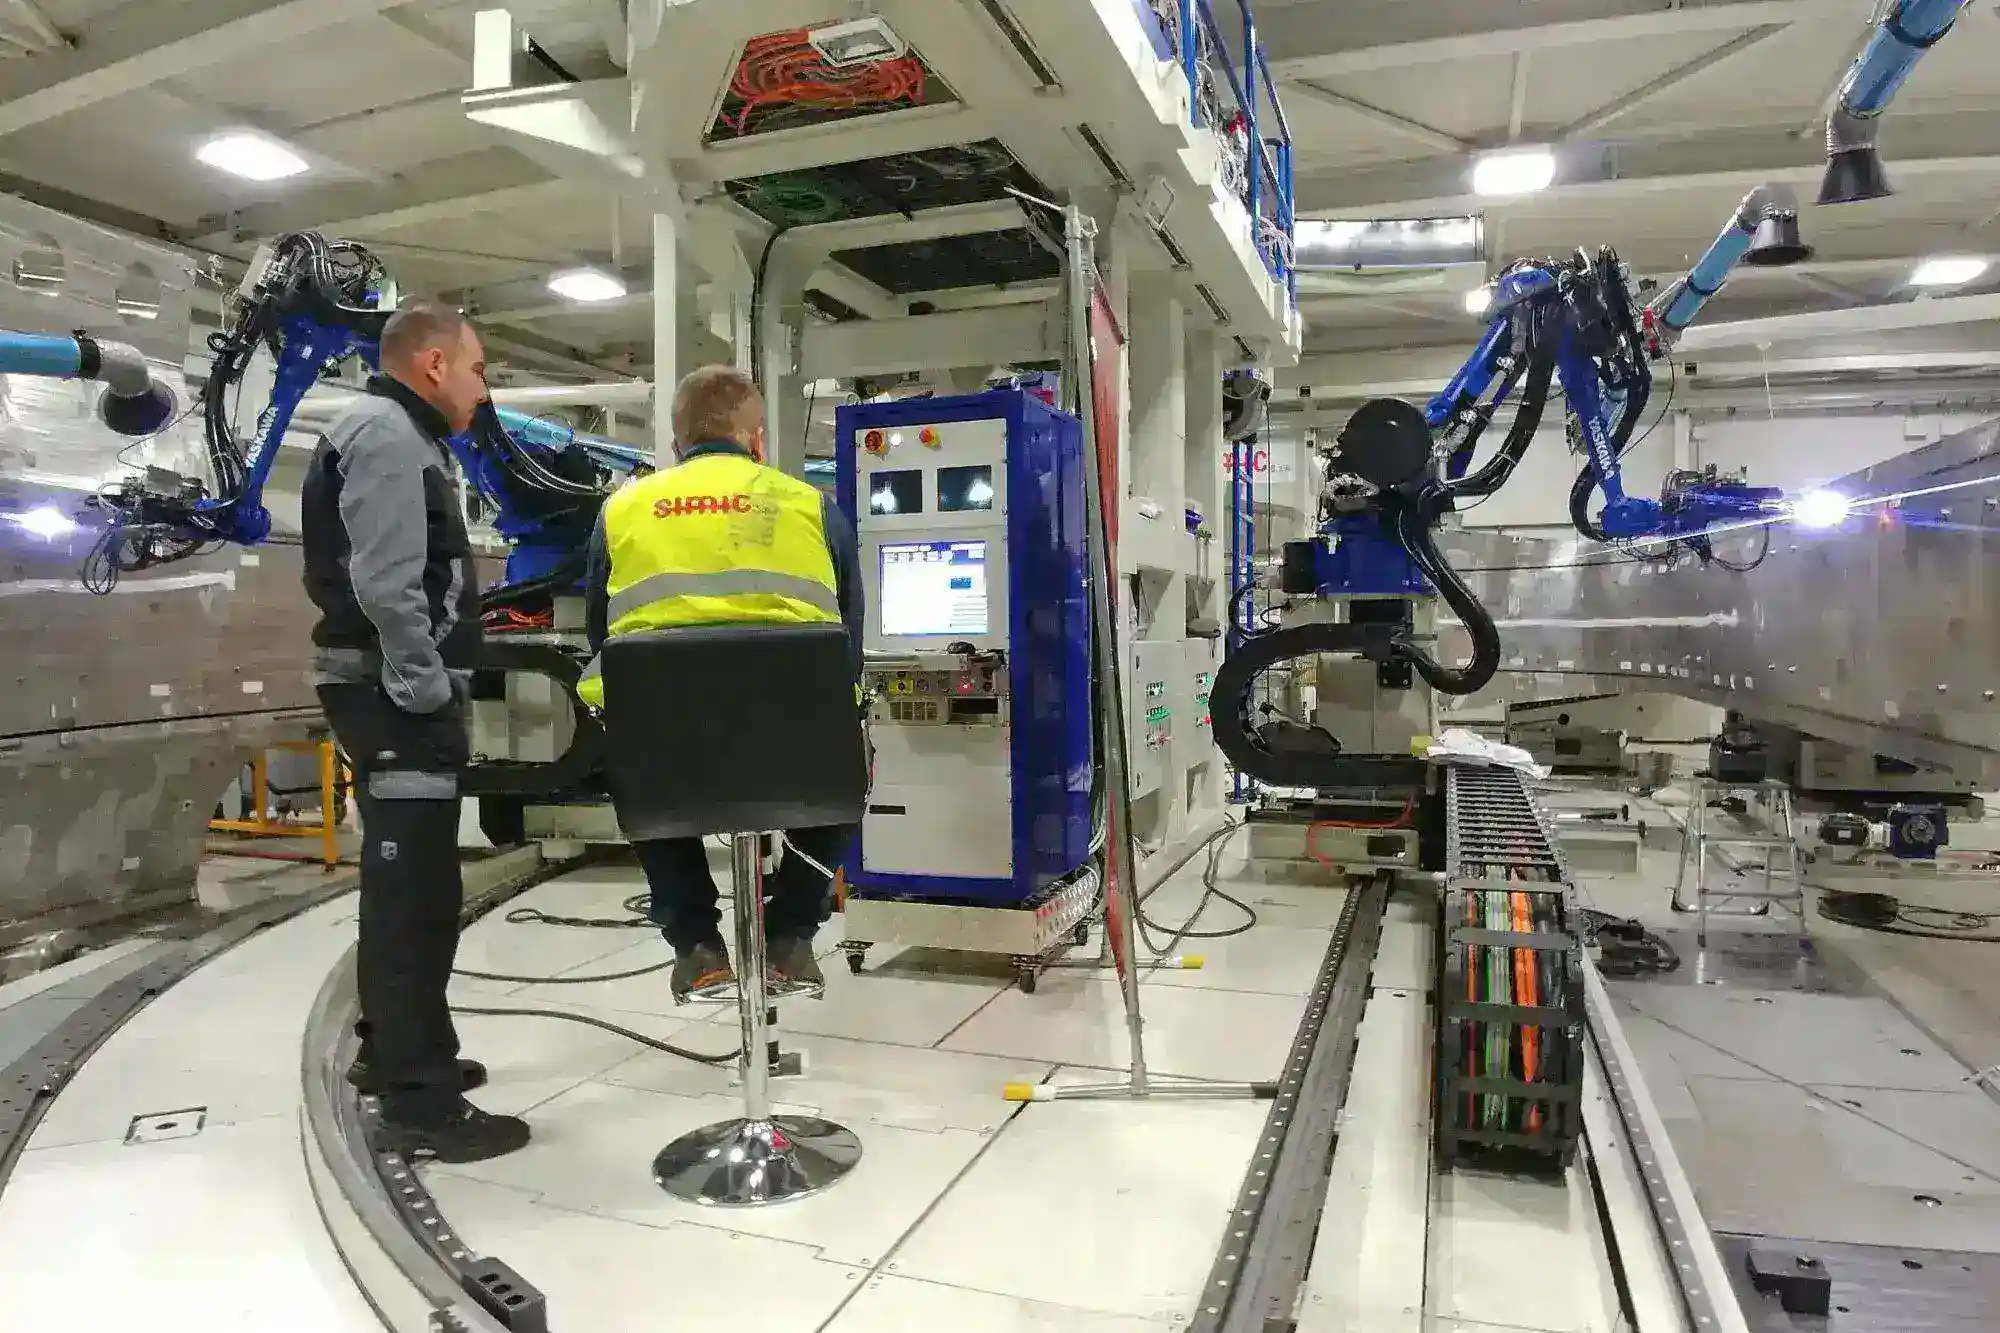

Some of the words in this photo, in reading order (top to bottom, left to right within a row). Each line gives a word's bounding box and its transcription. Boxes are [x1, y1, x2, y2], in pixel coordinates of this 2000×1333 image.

[245, 406, 280, 468] YASKAWA
[1588, 415, 1616, 480] YASKAWA
[653, 494, 752, 519] SIMIC
